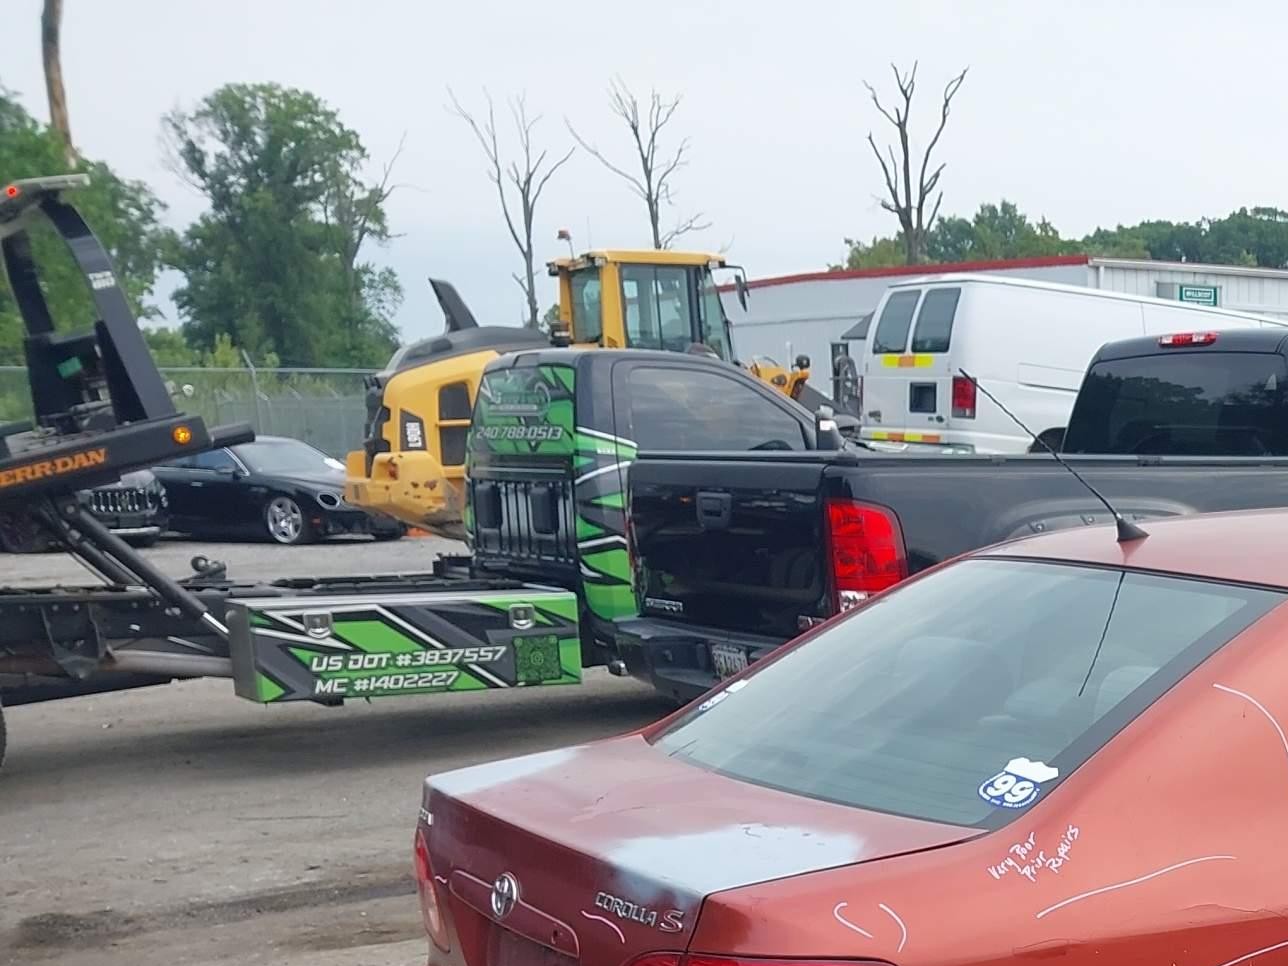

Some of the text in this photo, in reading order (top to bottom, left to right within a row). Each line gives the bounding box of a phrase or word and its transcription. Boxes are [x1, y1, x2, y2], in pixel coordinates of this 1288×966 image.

[311, 646, 507, 672] US DOT #3837557
[314, 671, 459, 694] MC #1402227
[986, 774, 1035, 803] 99
[987, 857, 1022, 879] Very
[595, 891, 685, 933] COROLLA S
